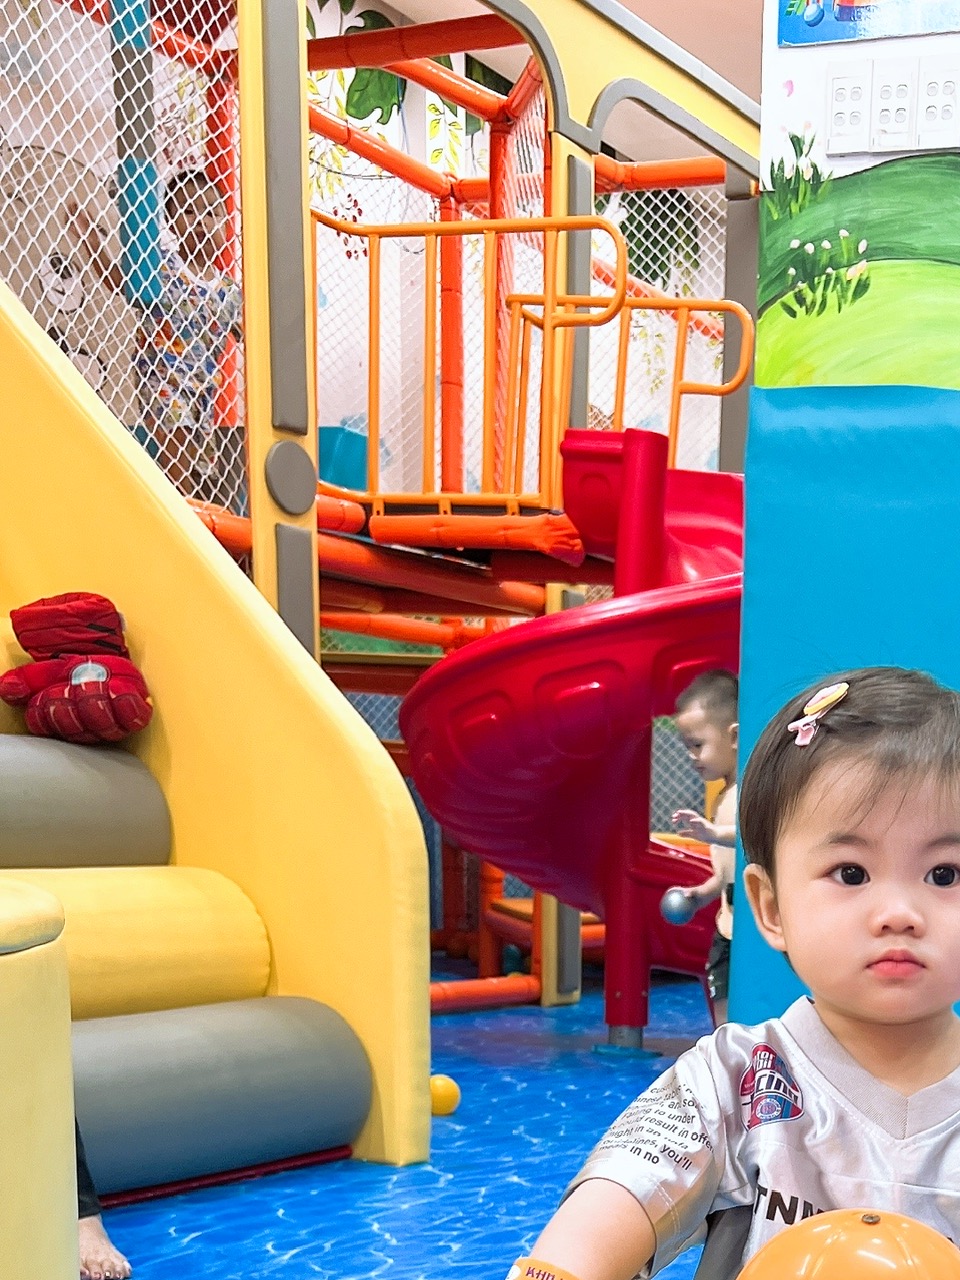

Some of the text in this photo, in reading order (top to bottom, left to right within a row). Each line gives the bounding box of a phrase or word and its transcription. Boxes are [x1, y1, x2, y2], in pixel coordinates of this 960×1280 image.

[654, 1108, 666, 1116] to
[644, 1116, 678, 1133] result
[678, 1127, 689, 1139] in
[629, 1145, 643, 1156] in
[643, 1151, 660, 1164] no
[660, 1144, 693, 1170] you'll
